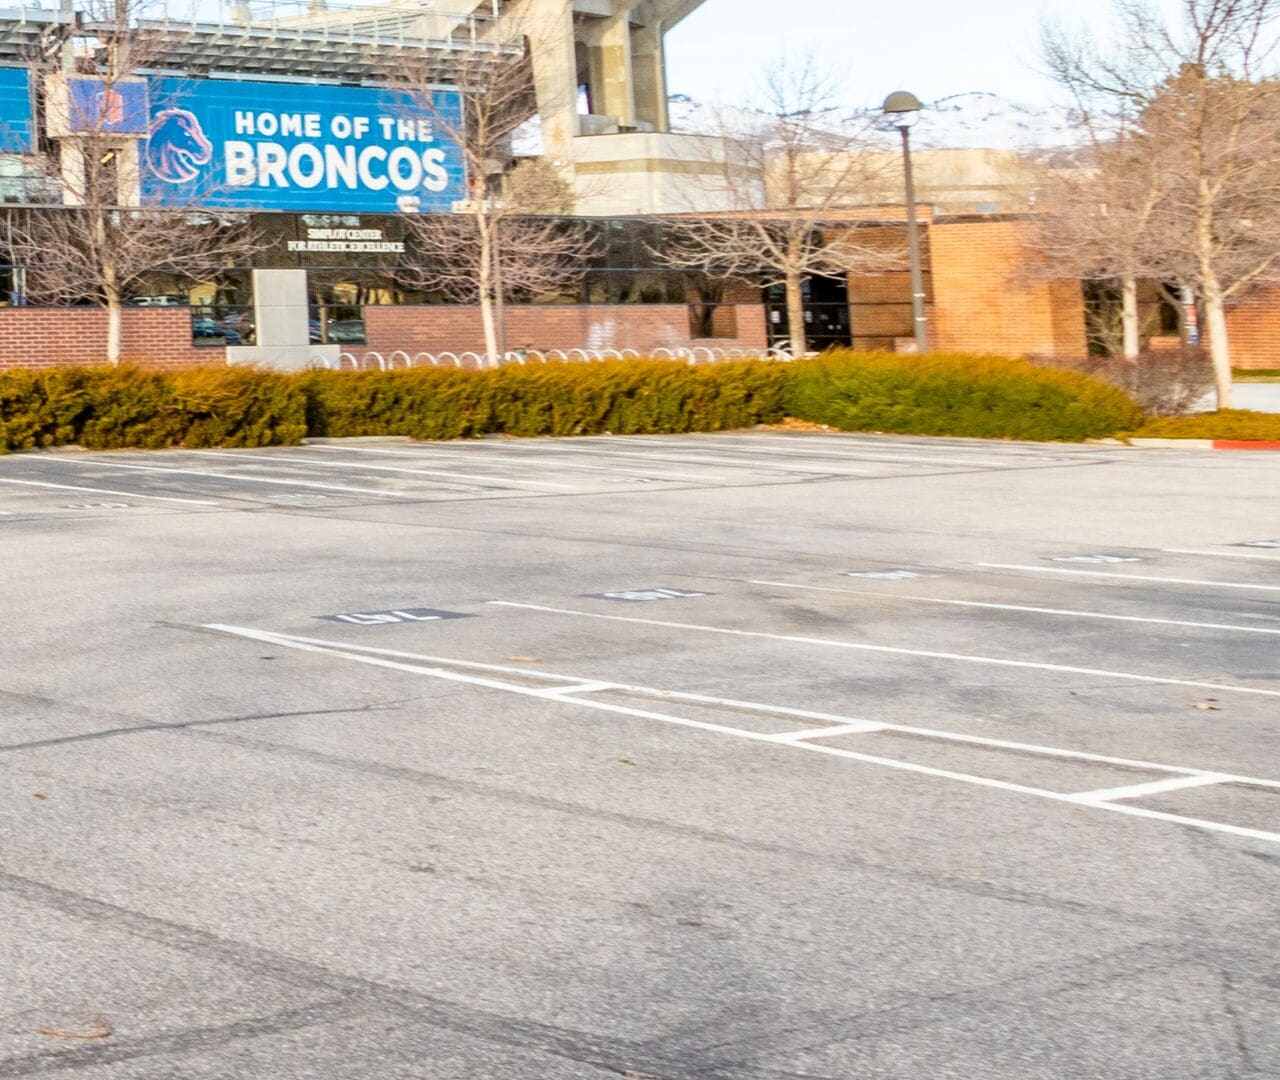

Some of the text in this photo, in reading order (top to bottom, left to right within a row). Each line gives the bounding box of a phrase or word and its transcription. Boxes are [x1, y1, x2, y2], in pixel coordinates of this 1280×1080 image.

[234, 110, 434, 143] HOME OF THE
[223, 139, 449, 193] BRONCOS
[287, 240, 307, 251] FOR
[347, 229, 383, 240] CENTER
